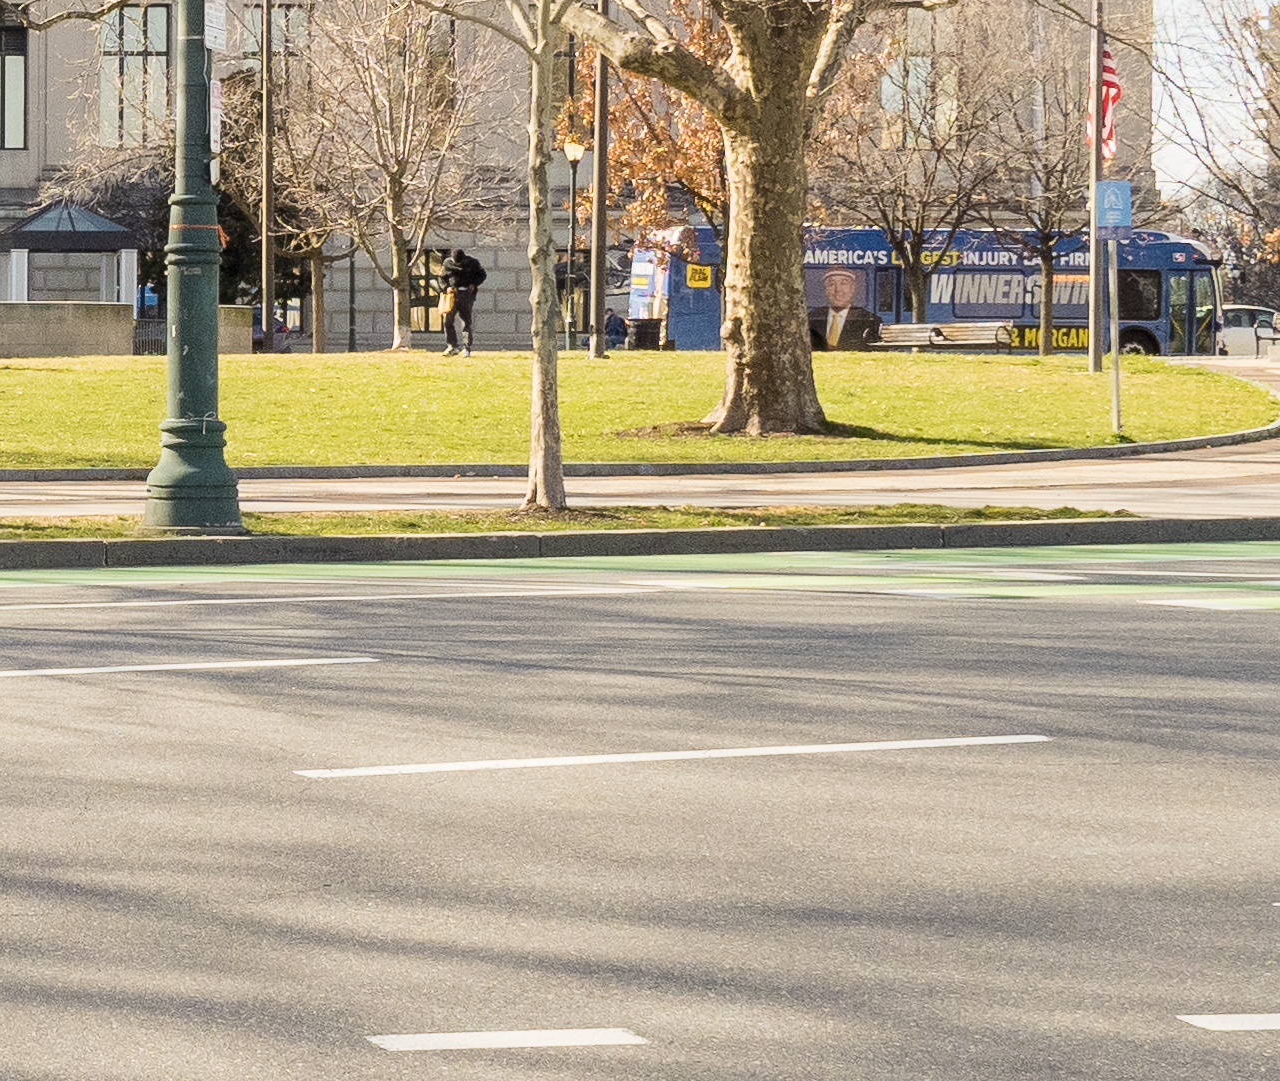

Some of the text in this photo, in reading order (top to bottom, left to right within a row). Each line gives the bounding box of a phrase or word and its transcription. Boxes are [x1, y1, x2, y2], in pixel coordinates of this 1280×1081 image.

[804, 250, 888, 265] AMERICA'S
[891, 251, 958, 265] LGEST
[963, 251, 1018, 266] INJURY
[930, 274, 1043, 304] WINNERS
